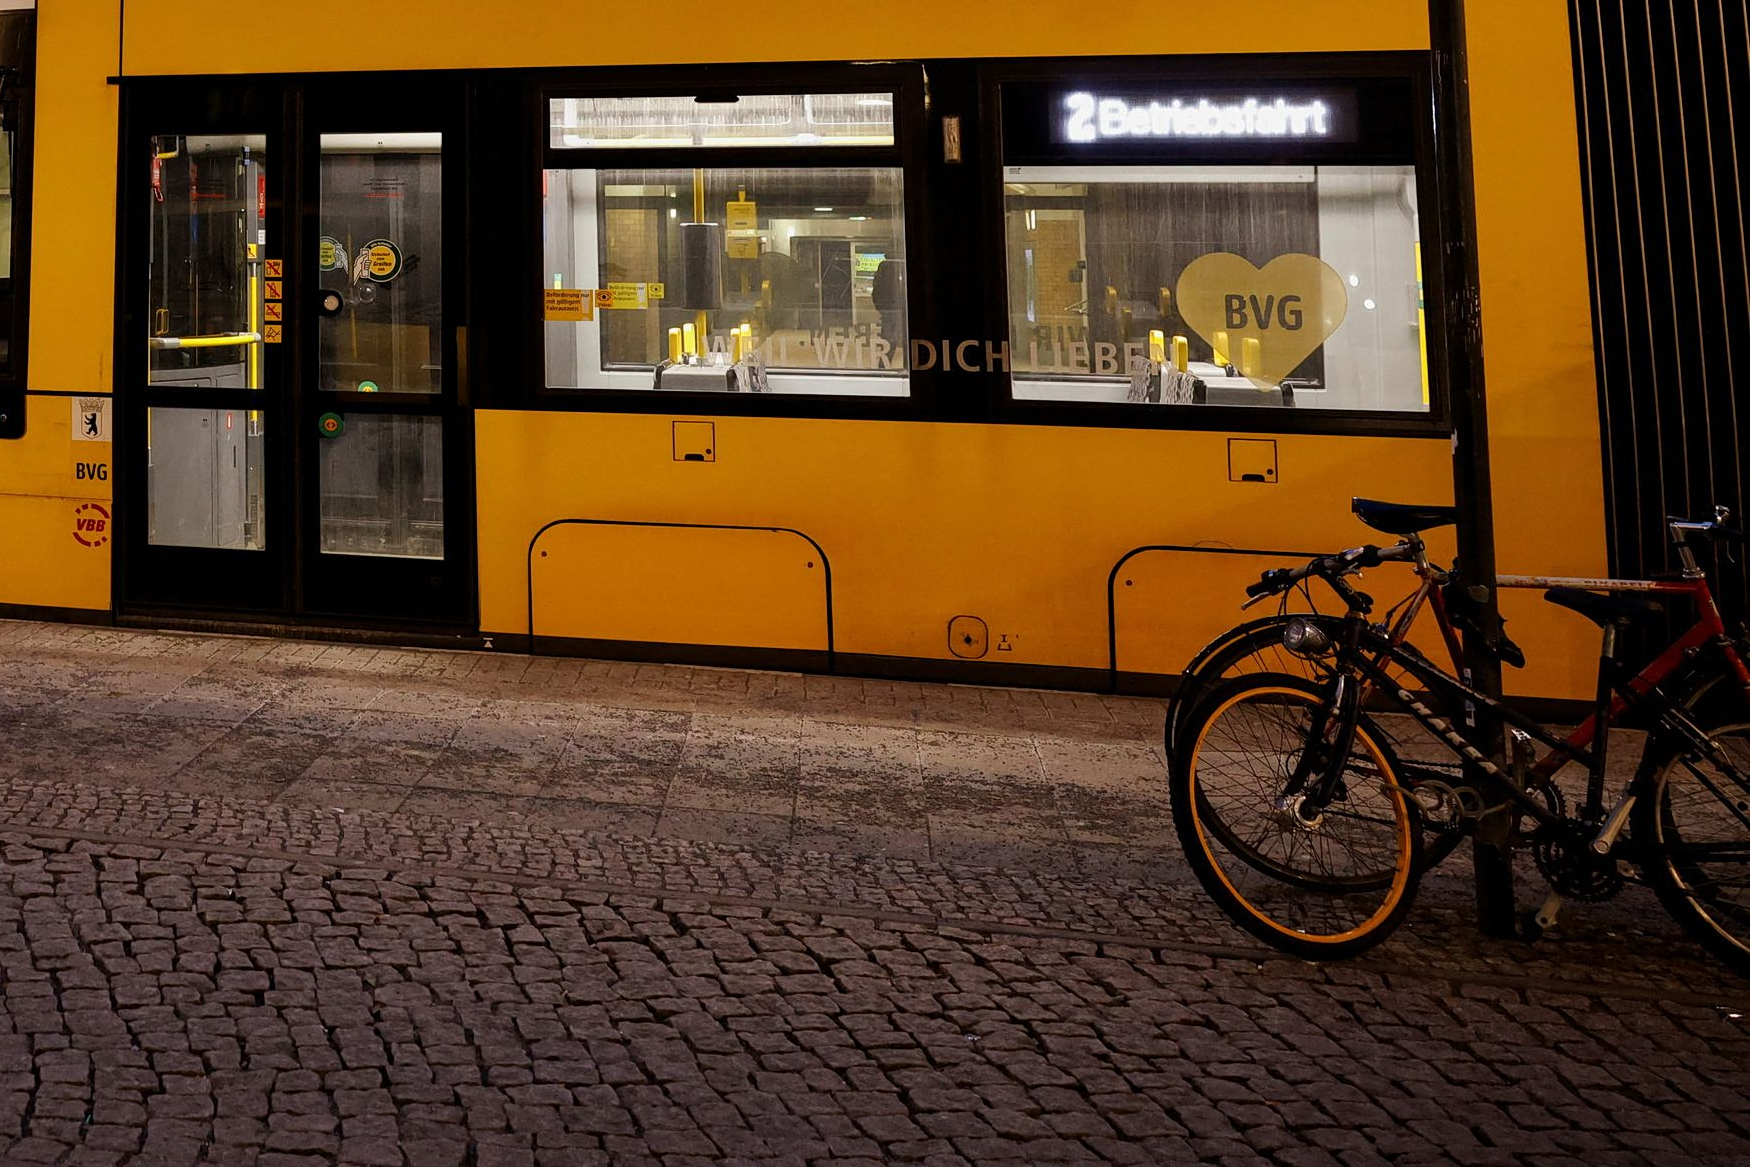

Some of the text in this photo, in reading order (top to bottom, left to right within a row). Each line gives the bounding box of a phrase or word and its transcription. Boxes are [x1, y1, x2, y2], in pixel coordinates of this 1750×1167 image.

[1065, 90, 1327, 143] 2 Betriebsfahrt
[1224, 294, 1304, 331] BVG
[815, 336, 892, 370] WIR
[911, 338, 1010, 374] DICH
[75, 462, 108, 482] BVG
[76, 517, 106, 533] VBB
